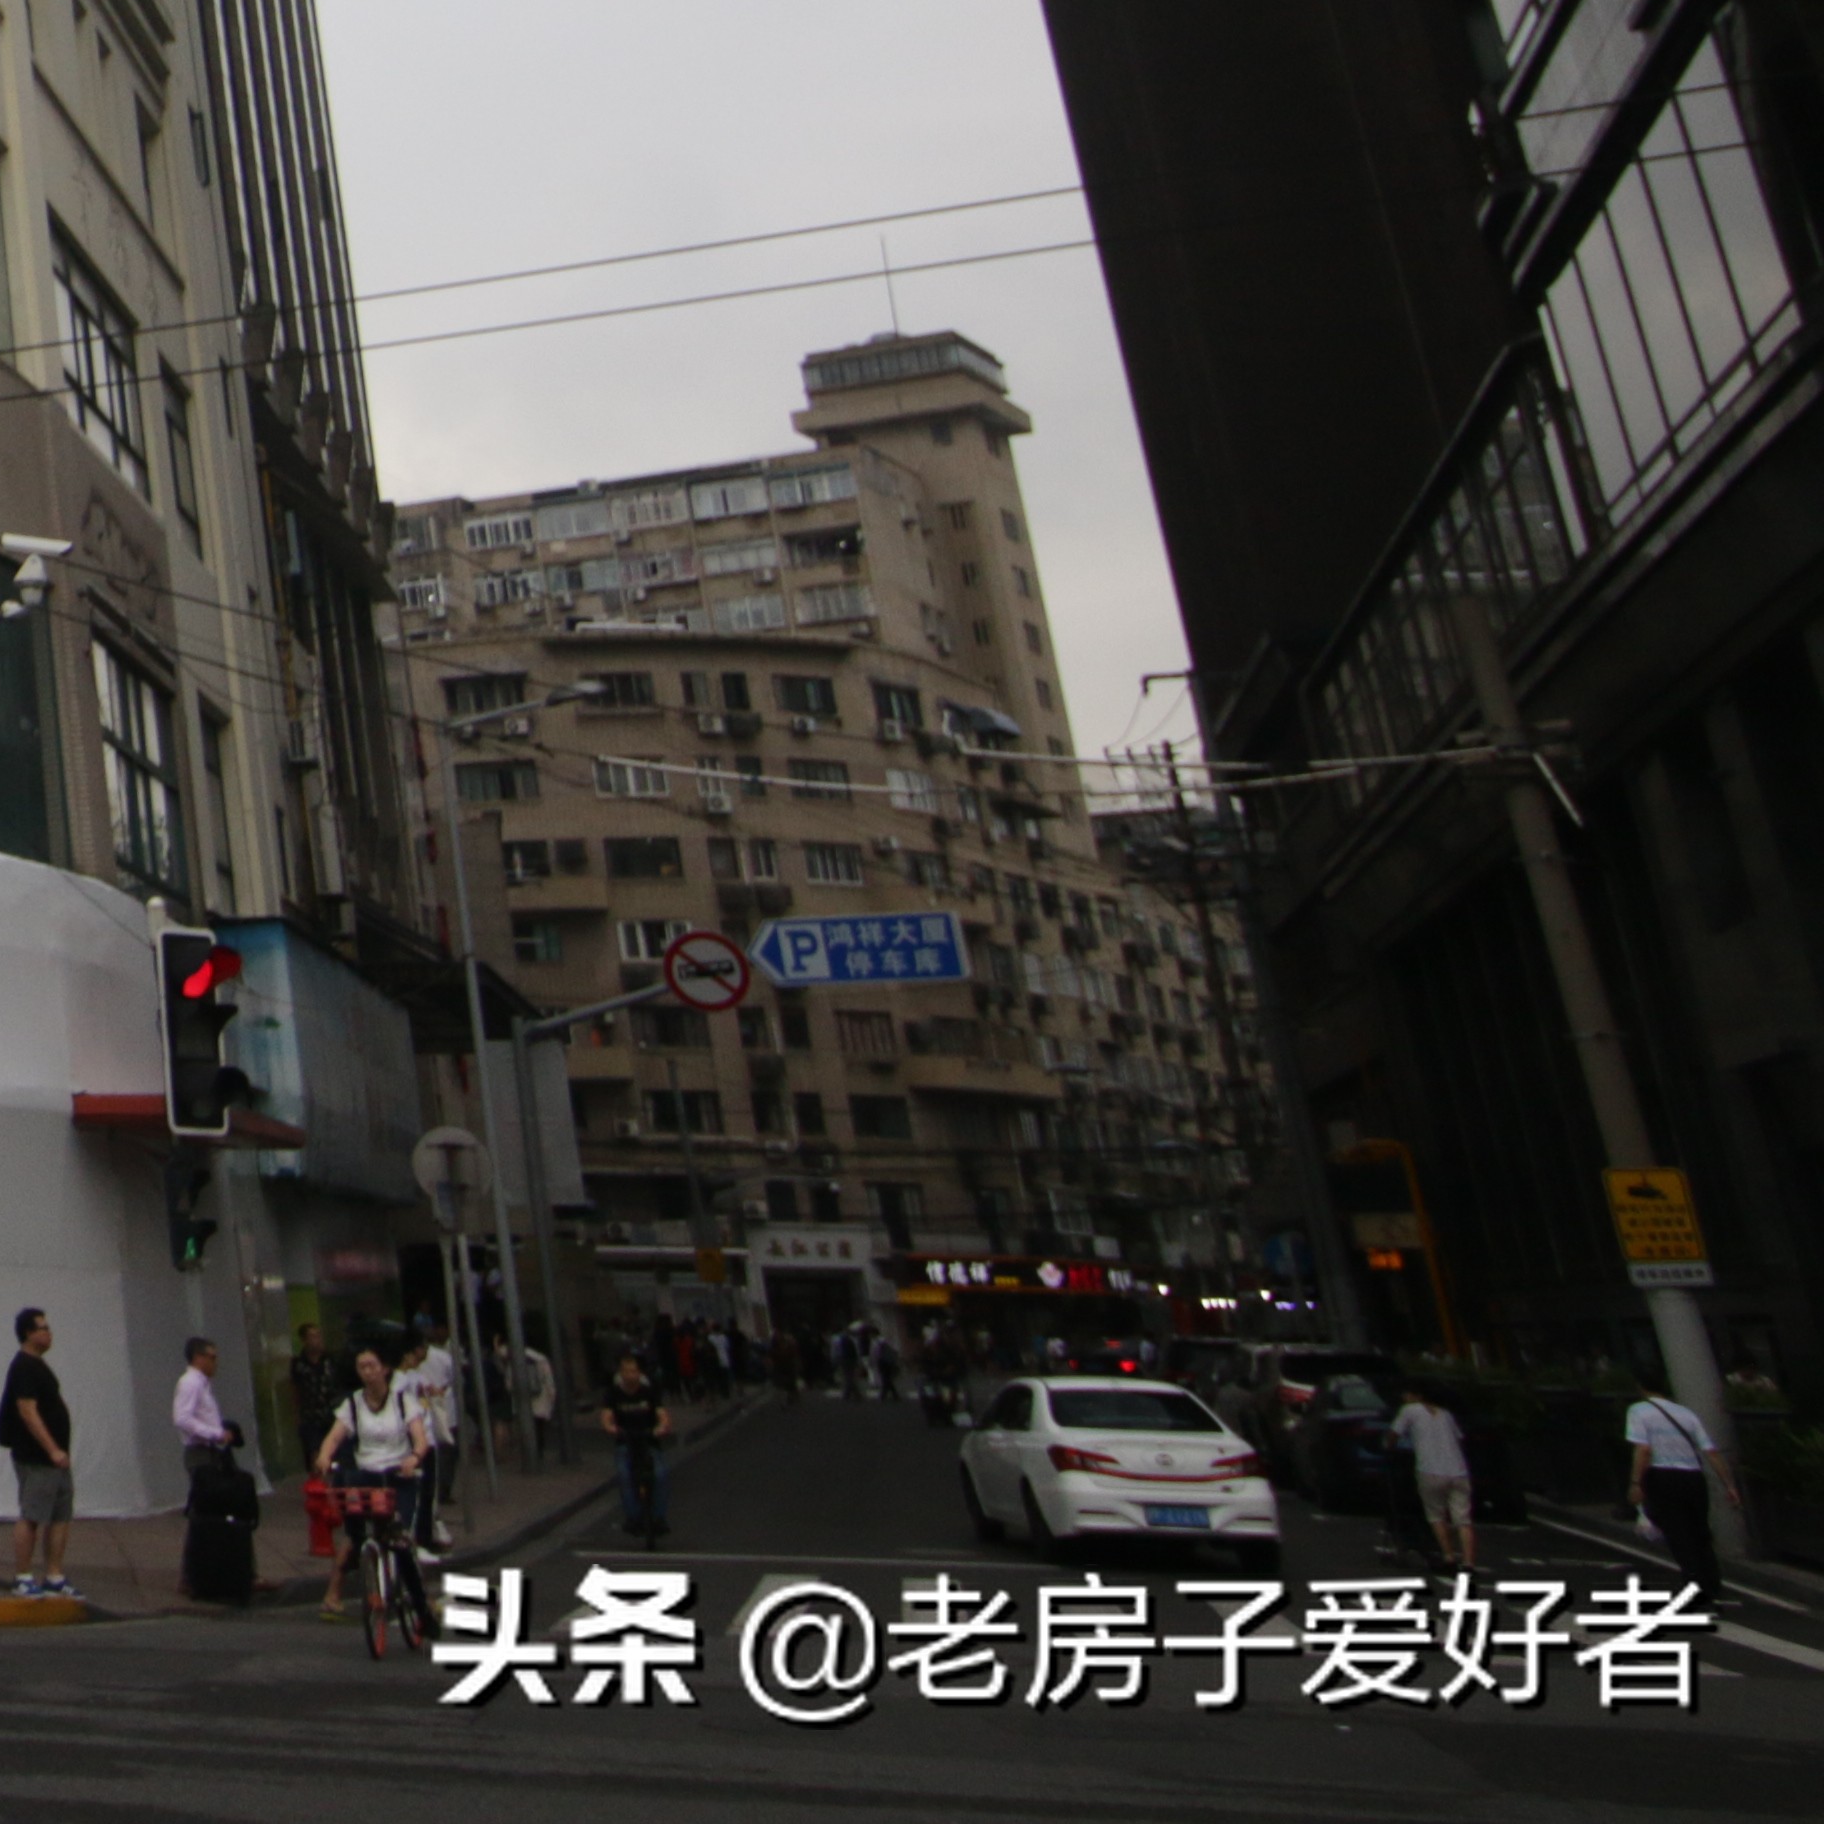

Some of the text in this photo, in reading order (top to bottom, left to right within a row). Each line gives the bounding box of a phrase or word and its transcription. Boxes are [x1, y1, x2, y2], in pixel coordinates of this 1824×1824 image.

[785, 930, 817, 972] P
[846, 948, 942, 977] 停车库
